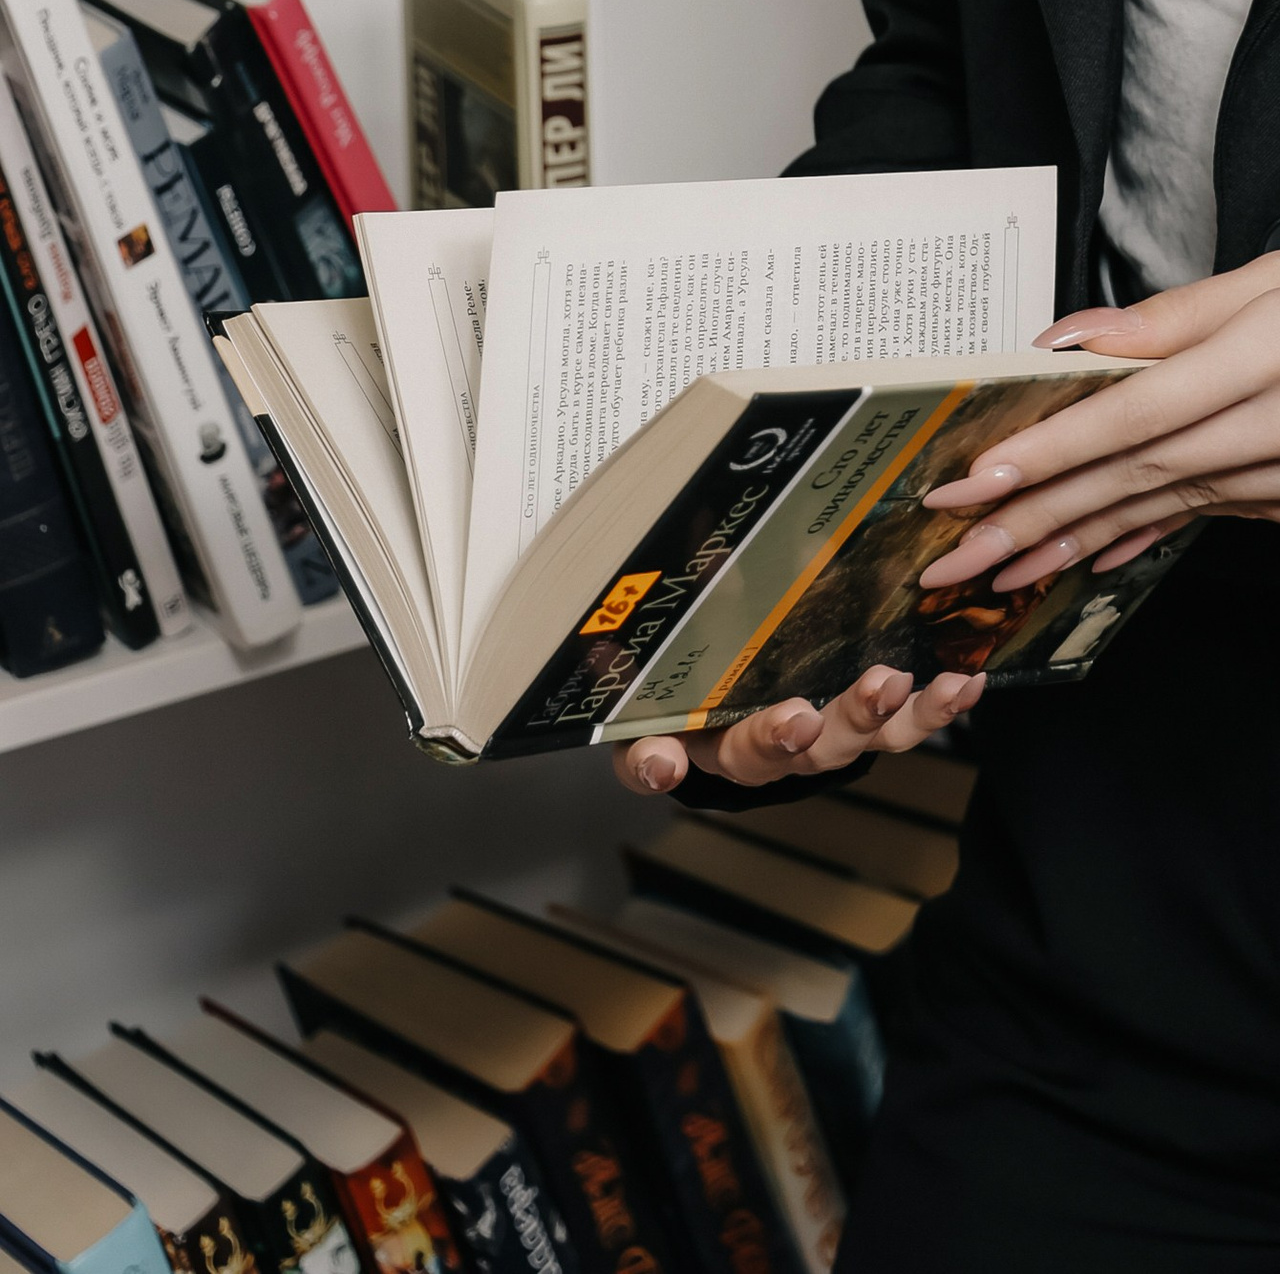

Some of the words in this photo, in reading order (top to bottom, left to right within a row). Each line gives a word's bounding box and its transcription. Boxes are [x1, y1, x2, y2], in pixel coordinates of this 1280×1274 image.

[544, 40, 585, 102] ЛИ
[687, 255, 695, 270] он
[701, 254, 709, 268] на
[726, 252, 735, 271] си-
[817, 245, 827, 259] ей
[856, 243, 865, 278] мало-
[881, 240, 890, 283] стоило
[894, 239, 903, 276] точно
[907, 239, 916, 263] ста-
[920, 237, 929, 262] ста-
[930, 236, 944, 289] фигурку
[944, 236, 954, 260] Она
[957, 235, 968, 268] когда
[968, 234, 980, 256] Од-
[980, 233, 994, 291] глубокой
[564, 264, 573, 285] это
[591, 262, 603, 289] она,
[618, 261, 631, 303] разли-
[646, 258, 655, 277] ка-
[712, 253, 725, 294] случа-
[737, 251, 751, 293] Урсула
[764, 249, 775, 280] Ама-
[791, 247, 801, 305] ответила
[818, 262, 828, 291] день
[830, 244, 840, 294] течение
[919, 266, 930, 297] днем
[463, 279, 478, 318] Реме-
[577, 264, 587, 306] незна-
[604, 272, 614, 318] святых
[645, 283, 657, 311] мне,
[656, 257, 671, 317] Рафаила?
[672, 255, 685, 319] сведения,
[686, 275, 695, 295] как
[841, 243, 854, 327] поднималось
[867, 241, 881, 334] передвигались
[893, 281, 904, 304] уже
[906, 279, 917, 308] руки
[944, 266, 953, 311] местах.
[956, 275, 968, 312] тогда,
[966, 261, 978, 337] хозяйством.
[563, 290, 572, 319] хотя
[587, 292, 600, 329] Когда
[684, 300, 696, 333] того,
[697, 274, 711, 349] определять
[709, 299, 722, 346] Иногда
[722, 277, 737, 340] Амаранта
[763, 286, 773, 335] сказала
[817, 295, 826, 321] этот
[854, 282, 866, 333] галерее,
[878, 289, 891, 331] Урсуле
[892, 309, 901, 331] она
[979, 297, 989, 333] своей
[560, 324, 573, 366] могла,
[574, 312, 585, 354] самых
[613, 308, 628, 361] ребенка
[643, 317, 652, 357] скажи
[669, 339, 679, 353] ей
[671, 323, 679, 335] те
[683, 336, 693, 351] до
[841, 333, 849, 347] то
[903, 314, 913, 344] Хотя
[955, 318, 964, 340] чем
[587, 333, 598, 369] доме.
[599, 322, 614, 403] переодевает
[654, 322, 668, 386] архангела
[556, 372, 571, 416] Урсула
[572, 359, 585, 395] курсе
[611, 365, 626, 417] обучает
[640, 379, 652, 406] ему,
[568, 412, 580, 445] быть
[553, 422, 568, 483] Аркадио,
[812, 449, 858, 492] Сто
[853, 410, 891, 448] лет
[808, 405, 921, 536] одиночества
[555, 616, 667, 726] Гарсиа
[638, 483, 770, 613] Маркес
[599, 582, 639, 627] 16+
[636, 679, 664, 702] 84
[718, 654, 751, 692] роман
